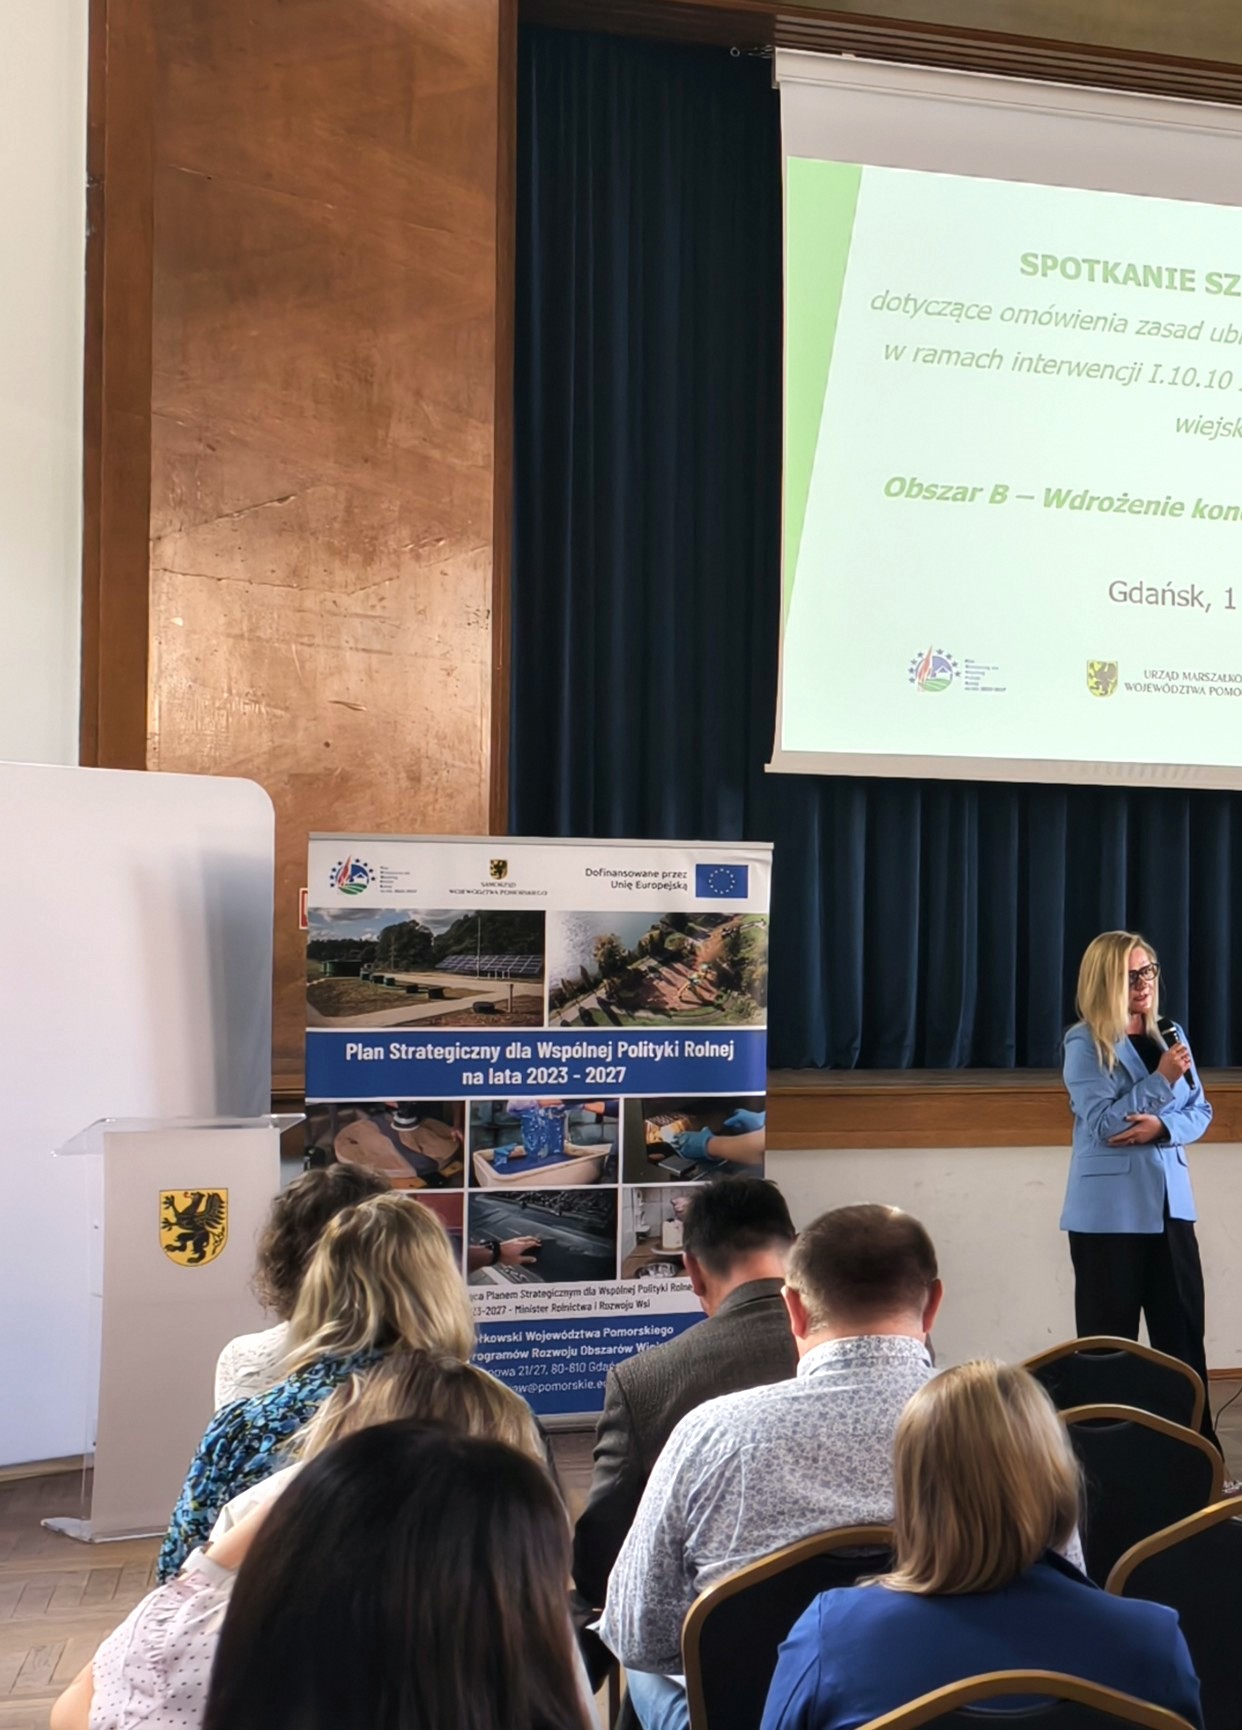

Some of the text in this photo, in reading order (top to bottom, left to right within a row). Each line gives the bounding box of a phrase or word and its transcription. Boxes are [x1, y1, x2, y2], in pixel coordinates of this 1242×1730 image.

[1019, 252, 1196, 293] SPOTKANIE
[870, 290, 993, 323] dotyczące
[1000, 304, 1128, 334] omówienia
[1135, 320, 1204, 341] zasad
[884, 344, 907, 361] w
[912, 347, 1003, 370] ramach
[1011, 352, 1143, 386] interwencji
[1148, 364, 1233, 390] I.10.10
[883, 476, 984, 503] Obszar
[988, 484, 1009, 504] B
[1043, 488, 1185, 518] Wdrożenie
[1108, 580, 1211, 613] Gdańsk,
[1224, 587, 1237, 610] 1
[1143, 669, 1179, 682] URZĄD
[1124, 682, 1206, 696] WOJEWÓDZTWA
[585, 867, 687, 881] Dofinansowane przez
[611, 880, 688, 892] Unię Europejską
[346, 1040, 735, 1063] Plan Strategiczny dla Wspólnej Polityki Rolnej
[462, 1071, 484, 1085] na
[488, 1068, 522, 1084] lata
[526, 1067, 568, 1084] 2023
[585, 1066, 626, 1083] 2027
[486, 1290, 518, 1300] Planem
[520, 1288, 582, 1300] Strategicznym
[583, 1286, 597, 1296] dla
[598, 1284, 636, 1296] Wspólnej
[637, 1283, 668, 1295] Polityki
[670, 1282, 693, 1292] Rolne
[514, 1304, 548, 1314] Minister
[551, 1302, 592, 1313] Rolnictwa
[599, 1299, 634, 1311] Rozwoju
[635, 1299, 650, 1309] Wsi
[525, 1328, 600, 1343] Województwa
[603, 1325, 674, 1338] Pomorskiego
[472, 1347, 530, 1363] rogramów
[532, 1345, 578, 1360] Rozwoju
[580, 1342, 633, 1356] Obszarów
[518, 1364, 548, 1376] 21/27,
[551, 1361, 586, 1374] 80-810
